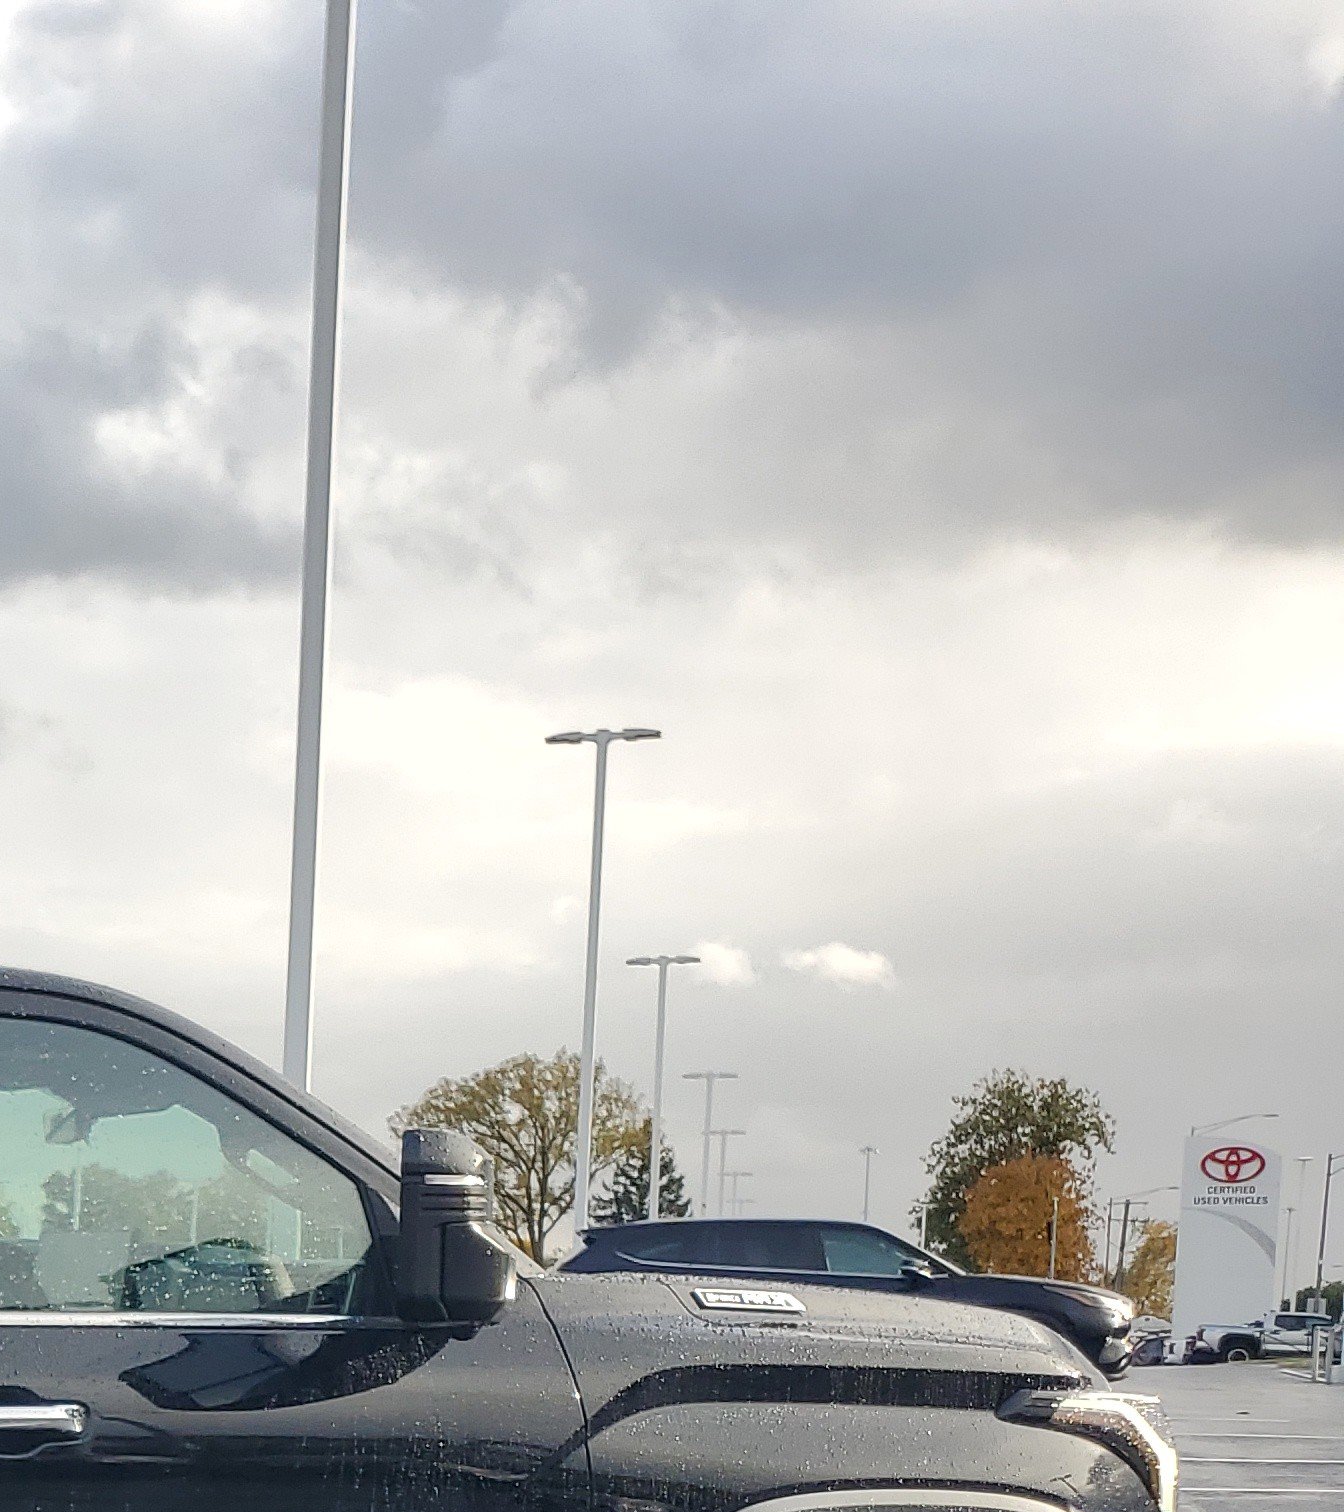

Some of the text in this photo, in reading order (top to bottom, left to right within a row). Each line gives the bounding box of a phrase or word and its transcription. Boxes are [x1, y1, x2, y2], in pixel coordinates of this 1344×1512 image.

[1207, 1185, 1256, 1195] CERTIFIED
[1193, 1196, 1269, 1205] USED VEHICLES
